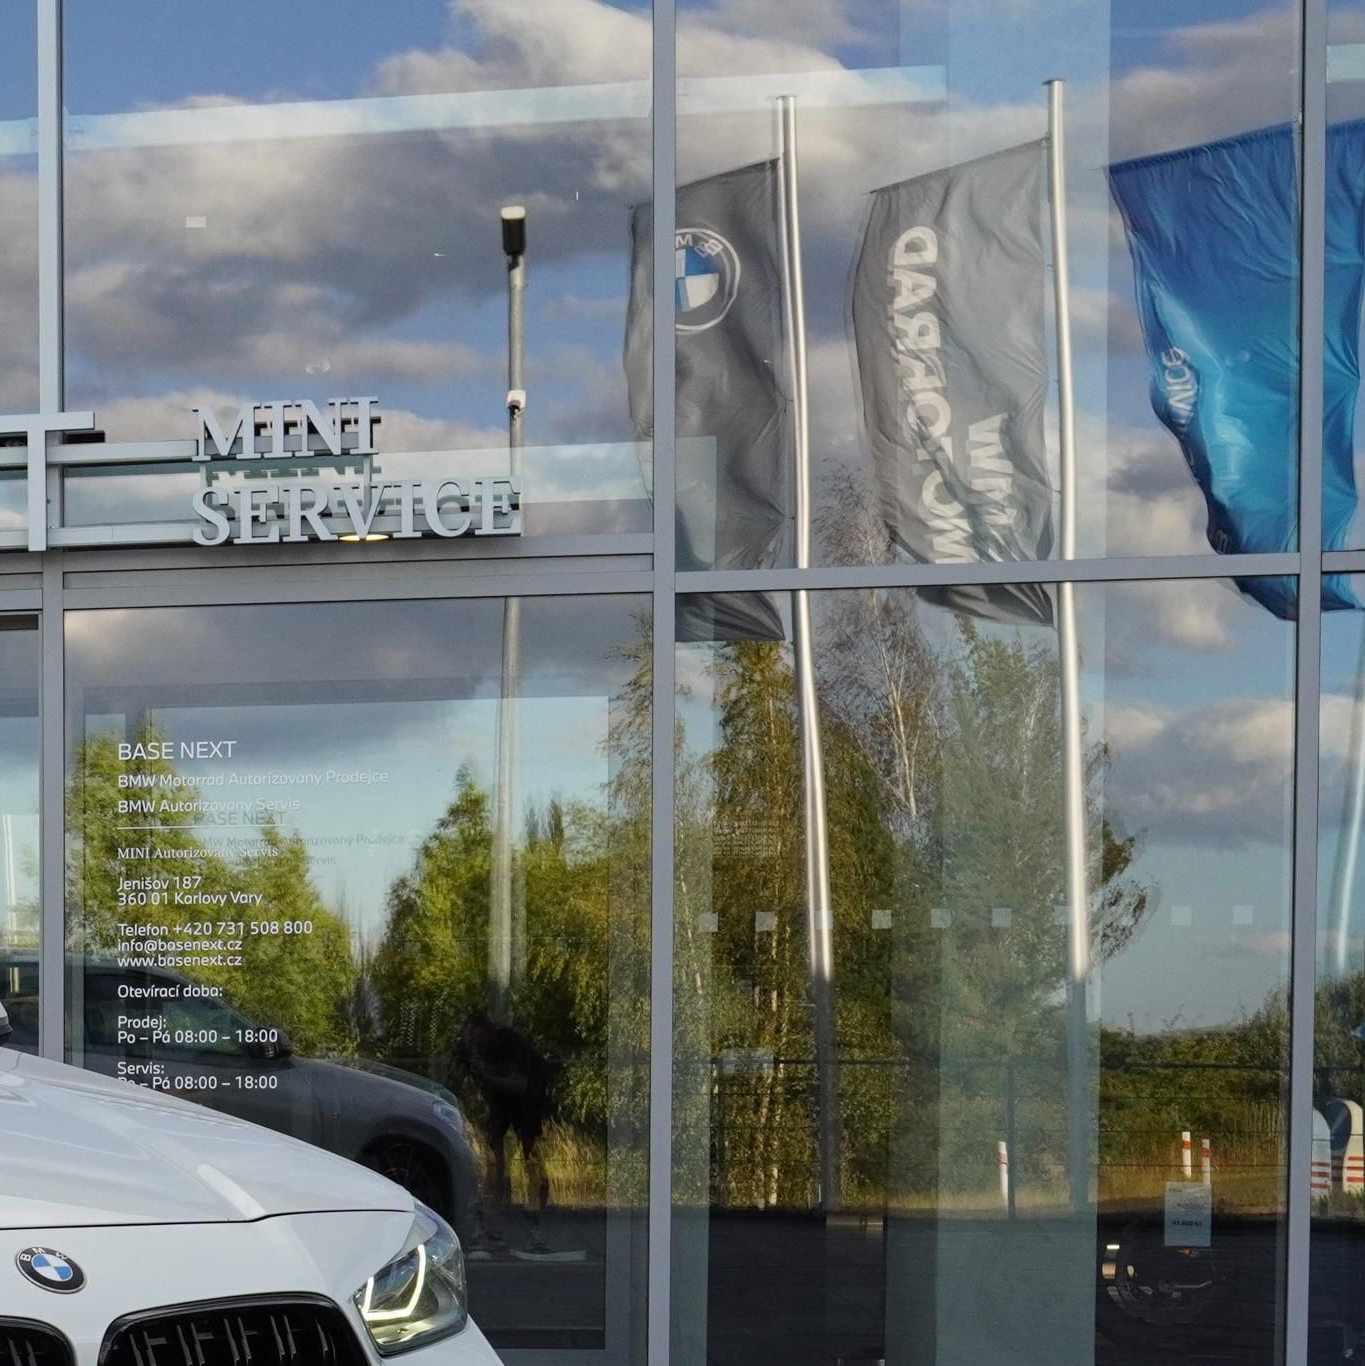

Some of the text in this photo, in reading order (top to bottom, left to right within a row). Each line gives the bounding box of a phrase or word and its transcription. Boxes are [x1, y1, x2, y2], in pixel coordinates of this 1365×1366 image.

[192, 396, 381, 462] MINI
[192, 475, 524, 546] SERVICE
[118, 741, 237, 760] BASE NEXT
[118, 769, 389, 788] BMW Motorrad Autorizovaný Prodejce
[118, 800, 156, 813] BMW
[256, 796, 301, 811] Servis
[117, 847, 150, 859] MINI
[239, 845, 279, 858] Servis
[117, 876, 202, 891] Jenišov 187
[117, 890, 263, 906] 360 01 Karlovy Vary
[117, 920, 313, 936] Telefon +420 731 508 800
[117, 938, 242, 953] info@basenext.cz
[117, 954, 242, 967] www.basenext.cz
[117, 984, 223, 998] Otevírací doba:
[117, 1015, 167, 1031] Prodej:
[117, 1031, 136, 1044] Po
[152, 1030, 170, 1044] Pá
[175, 1029, 218, 1043] 08:00
[235, 1029, 278, 1043] 18:00
[117, 1061, 165, 1075] Servis:
[152, 1076, 170, 1090] Pá
[174, 1075, 218, 1089] 08:00
[235, 1075, 278, 1089] 18:00
